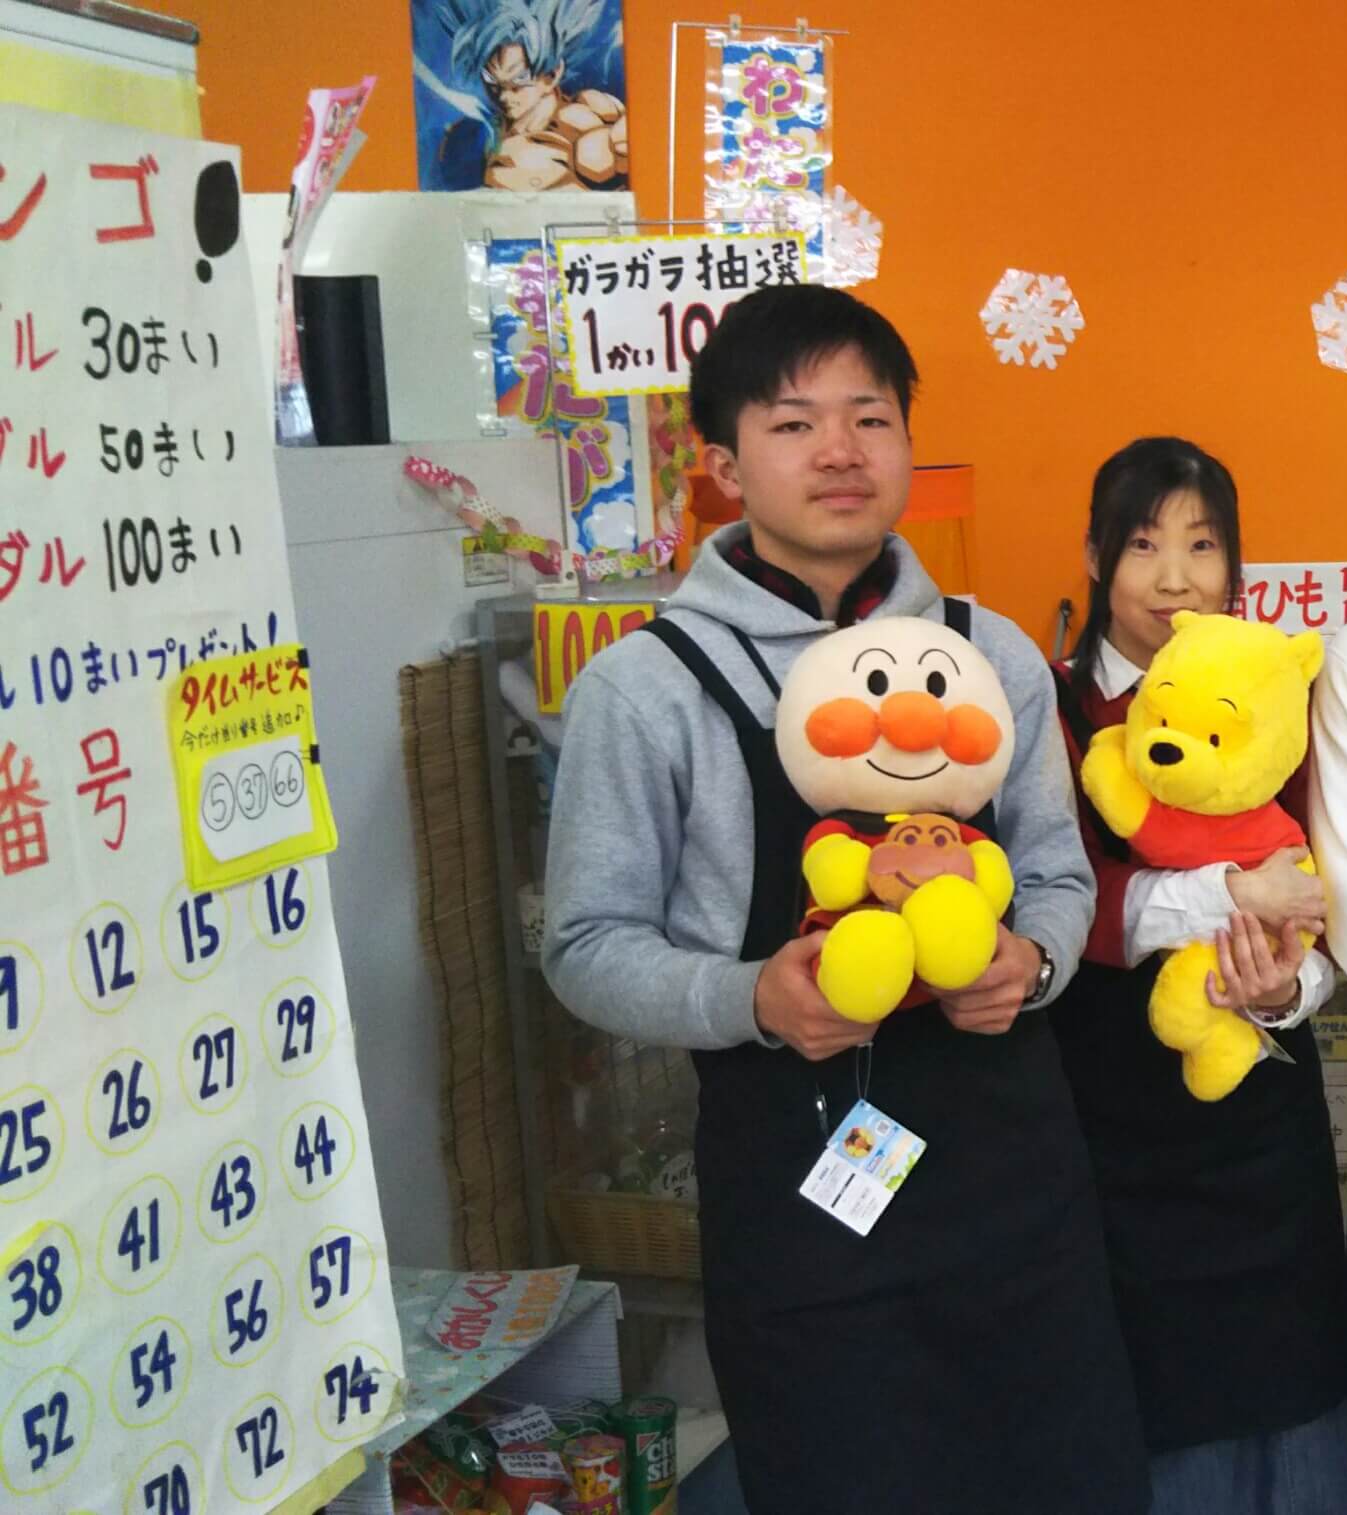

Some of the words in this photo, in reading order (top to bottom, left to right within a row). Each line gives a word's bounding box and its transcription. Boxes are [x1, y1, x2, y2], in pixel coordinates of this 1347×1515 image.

[564, 240, 799, 296] ガラガラ抽選
[81, 306, 219, 381] 30まい
[99, 421, 235, 478] 50まい
[103, 516, 242, 592] 100まい
[180, 656, 308, 722] タイムサービス
[209, 783, 226, 822] 5
[241, 772, 265, 812] 37
[274, 764, 298, 797] 66
[86, 921, 135, 998] 12
[178, 892, 220, 963] 15
[264, 867, 305, 935] 16
[0, 1100, 51, 1186] 25
[102, 1060, 151, 1139] 26
[193, 1027, 235, 1100] 27
[277, 995, 316, 1063] 29
[8, 1245, 63, 1332] 38
[118, 1198, 160, 1273] 41
[210, 1155, 256, 1227] 43
[295, 1115, 336, 1185] 44
[22, 1391, 74, 1473] 52
[130, 1330, 176, 1409] 54
[225, 1279, 268, 1355] 56
[309, 1236, 352, 1309] 57
[144, 1464, 190, 1515] 70
[235, 1406, 284, 1479] 72
[324, 1355, 380, 1424] 74
